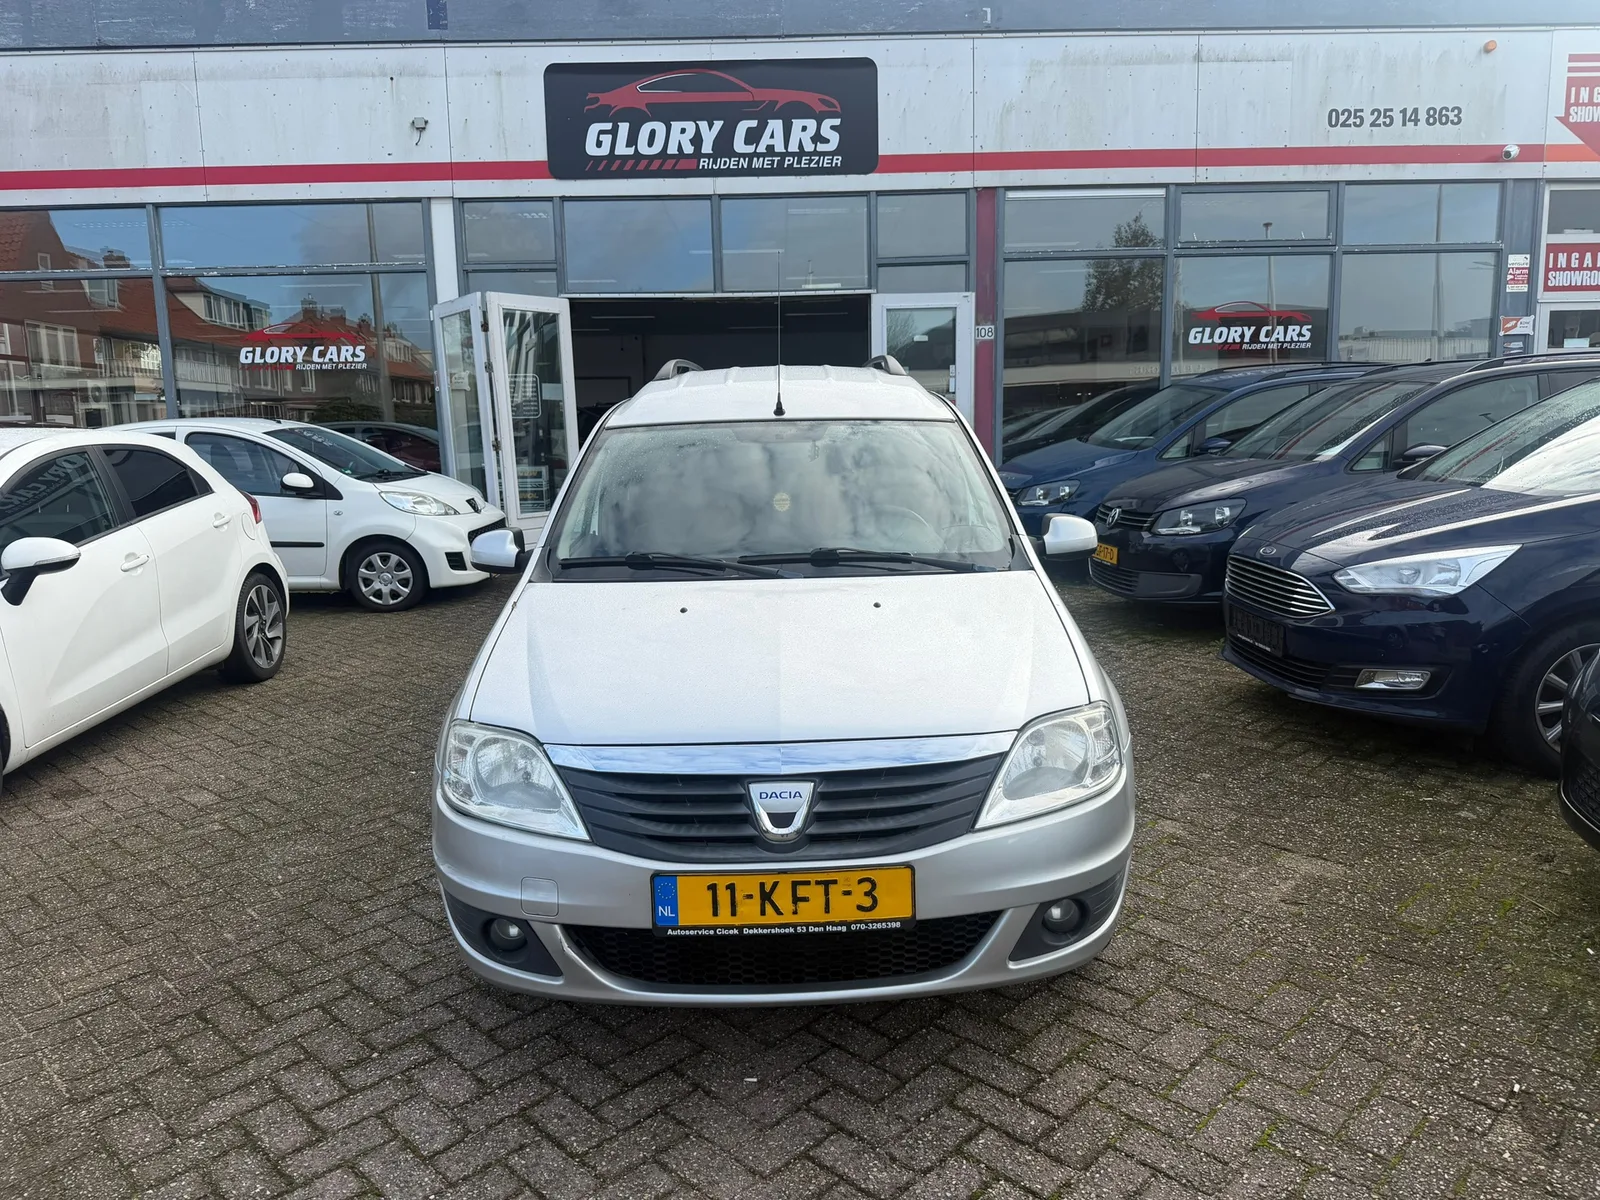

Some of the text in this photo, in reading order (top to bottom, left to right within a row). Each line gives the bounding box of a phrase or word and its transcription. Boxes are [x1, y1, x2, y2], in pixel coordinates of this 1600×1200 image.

[1327, 106, 1463, 128] 025 25 14 863
[584, 117, 842, 157] GLORY CARS
[698, 155, 842, 170] RIJDEN MET PLEZIER
[1507, 267, 1529, 275] Alarm
[1547, 270, 1600, 287] SHOWRO
[976, 326, 994, 338] 108
[1188, 324, 1313, 344] GLORY CARS
[240, 345, 366, 364] GLORY CARS
[338, 362, 368, 370] PLEZIER
[759, 790, 803, 800] DACIA
[706, 876, 879, 918] 11-KFT-3
[658, 905, 676, 917] NL
[667, 928, 715, 936] Autoservice
[743, 926, 795, 934] Dekkershoek
[808, 925, 824, 933] Den
[851, 921, 901, 931] 070-3265398
